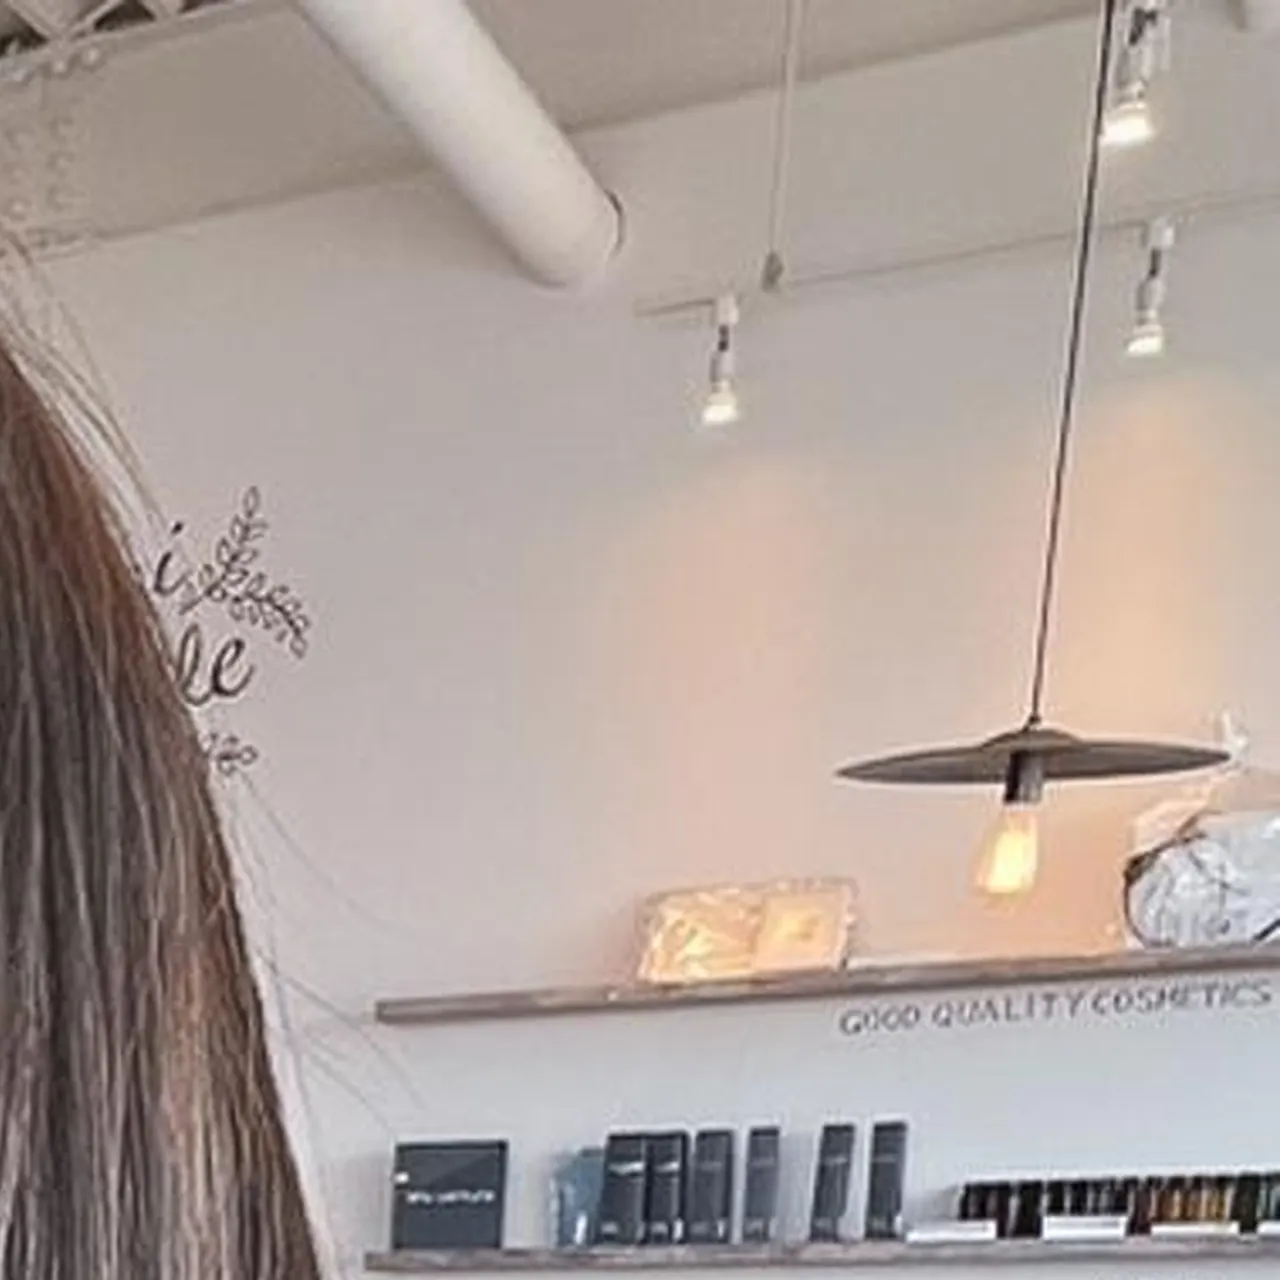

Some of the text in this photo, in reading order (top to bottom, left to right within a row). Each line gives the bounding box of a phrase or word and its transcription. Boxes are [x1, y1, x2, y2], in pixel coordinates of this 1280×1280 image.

[840, 979, 1272, 1036] GOOD QUALITY COSMETICS
